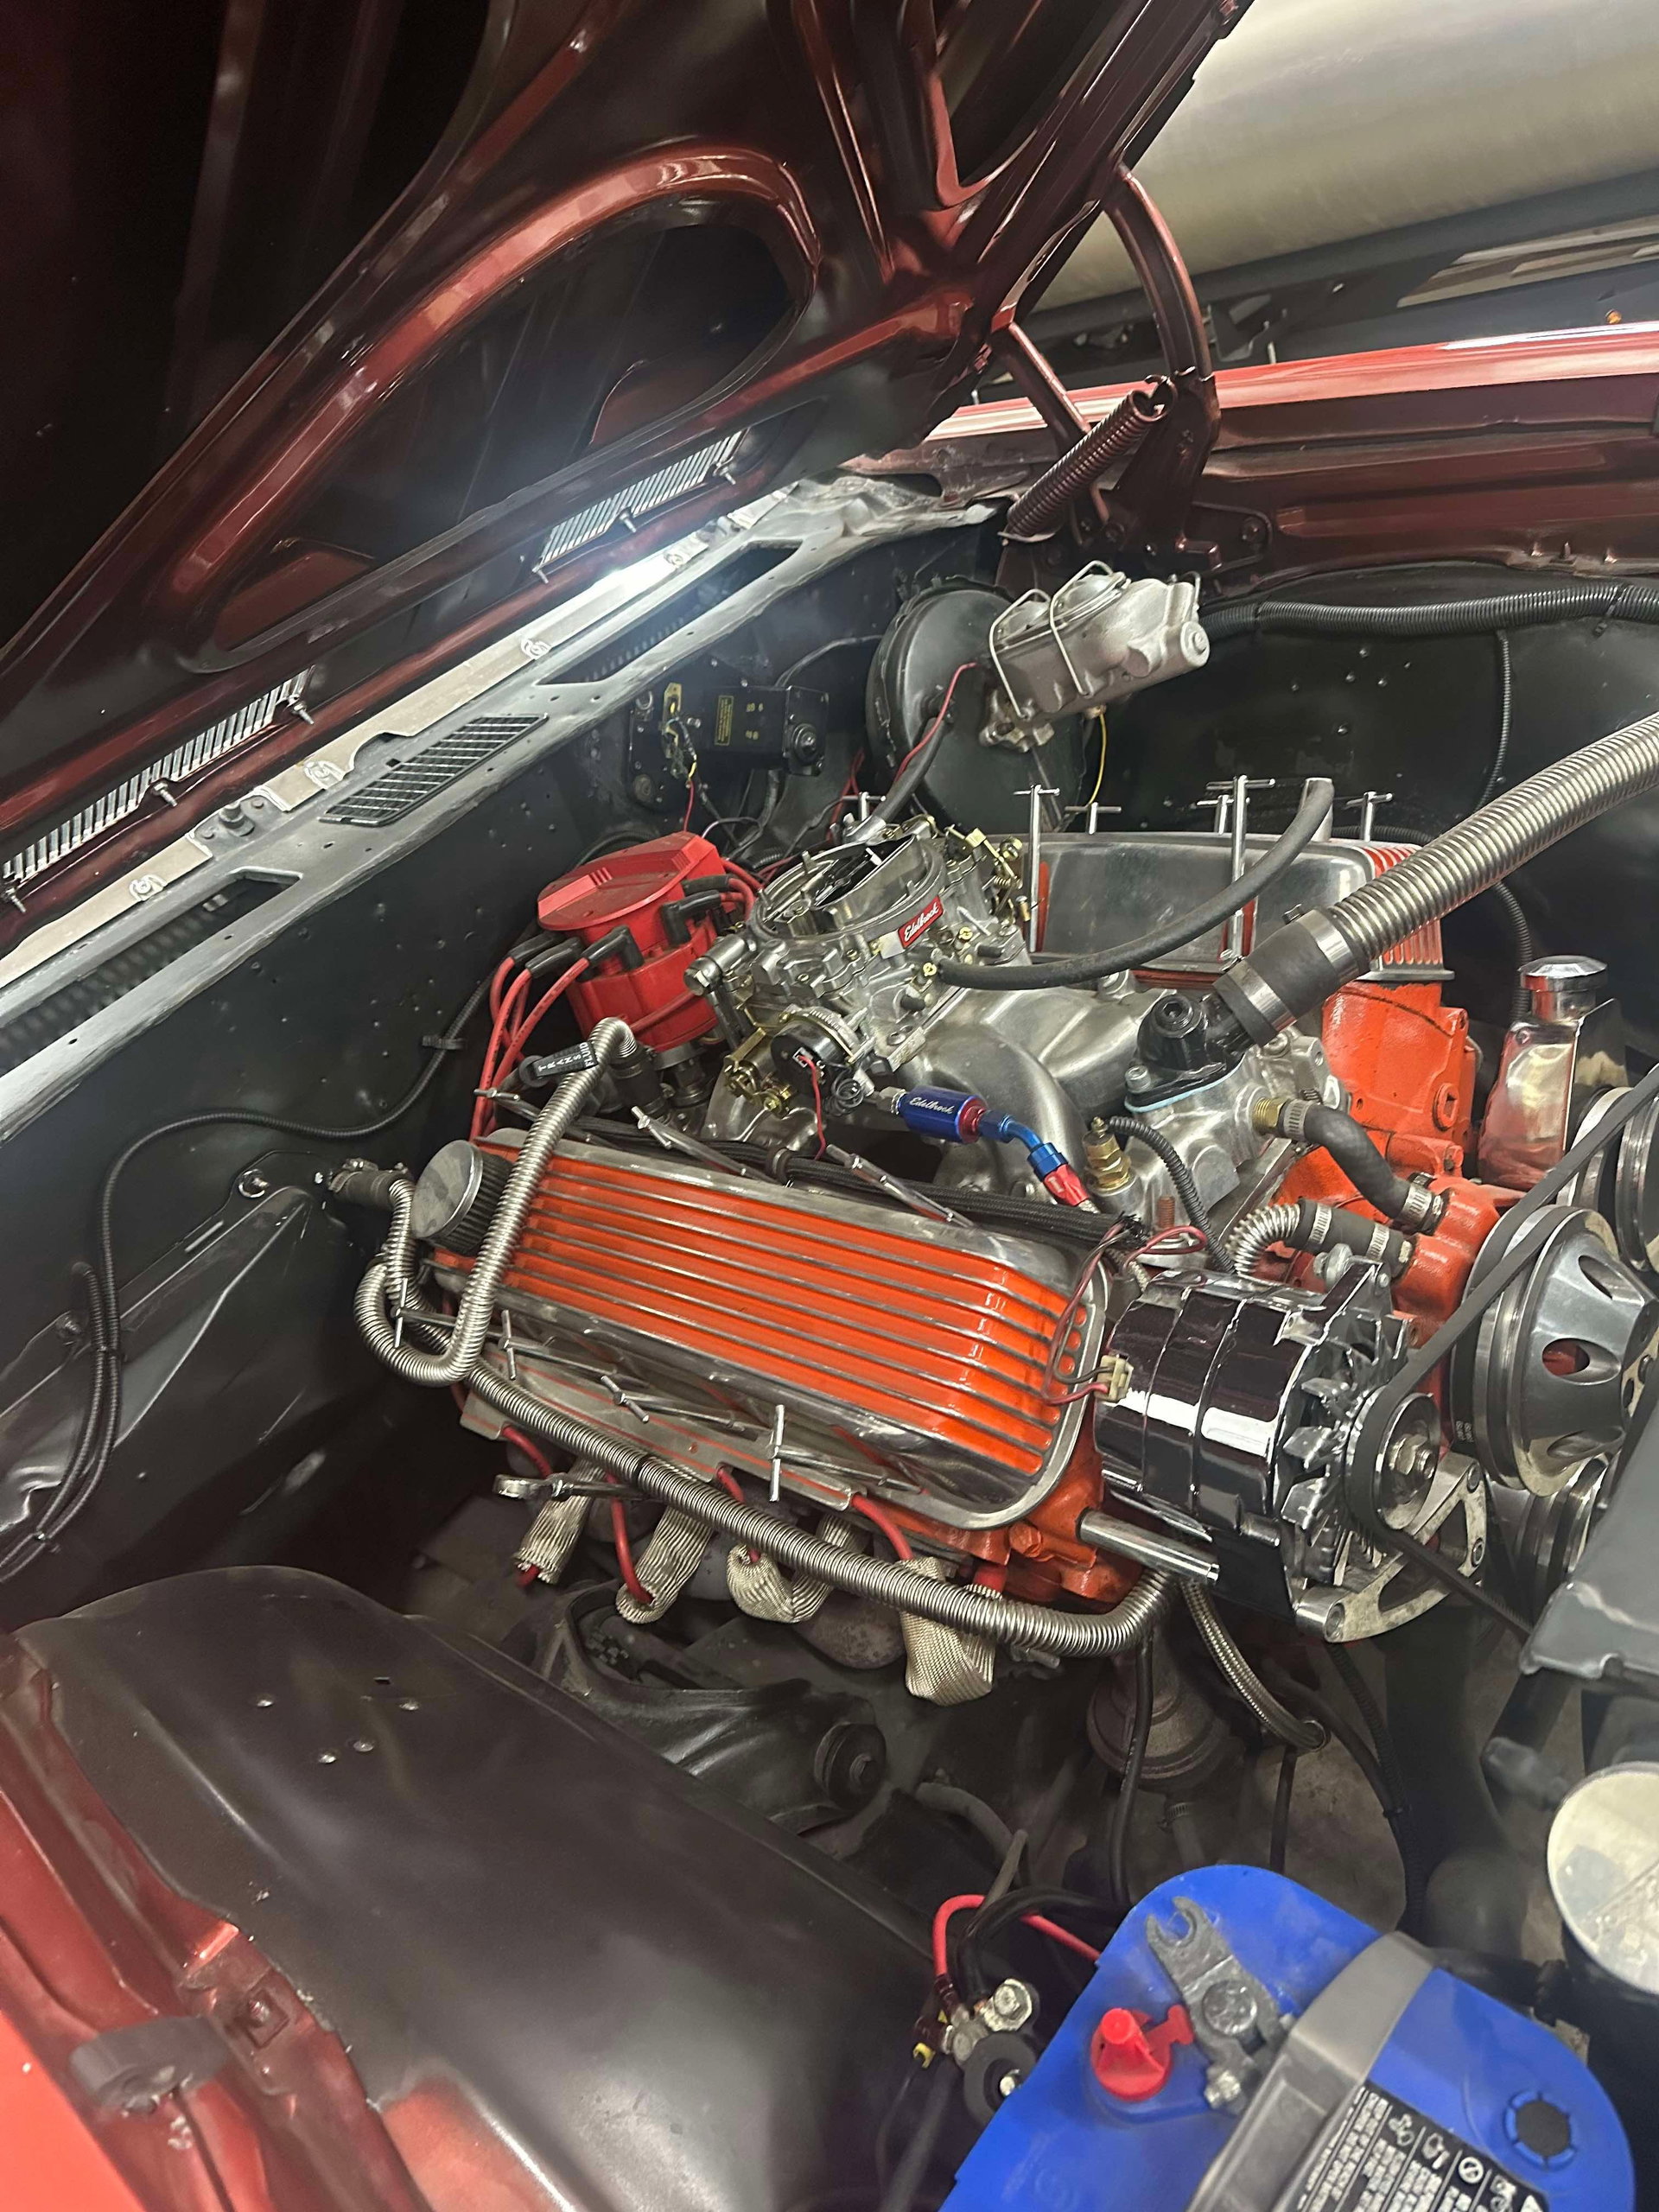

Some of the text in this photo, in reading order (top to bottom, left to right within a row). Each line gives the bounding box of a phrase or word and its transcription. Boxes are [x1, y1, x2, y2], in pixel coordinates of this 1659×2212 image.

[904, 902, 939, 942] Edelbrock
[538, 1052, 582, 1071] TRANS
[579, 1041, 594, 1067] FLUID
[909, 1096, 954, 1115] Edelbrock
